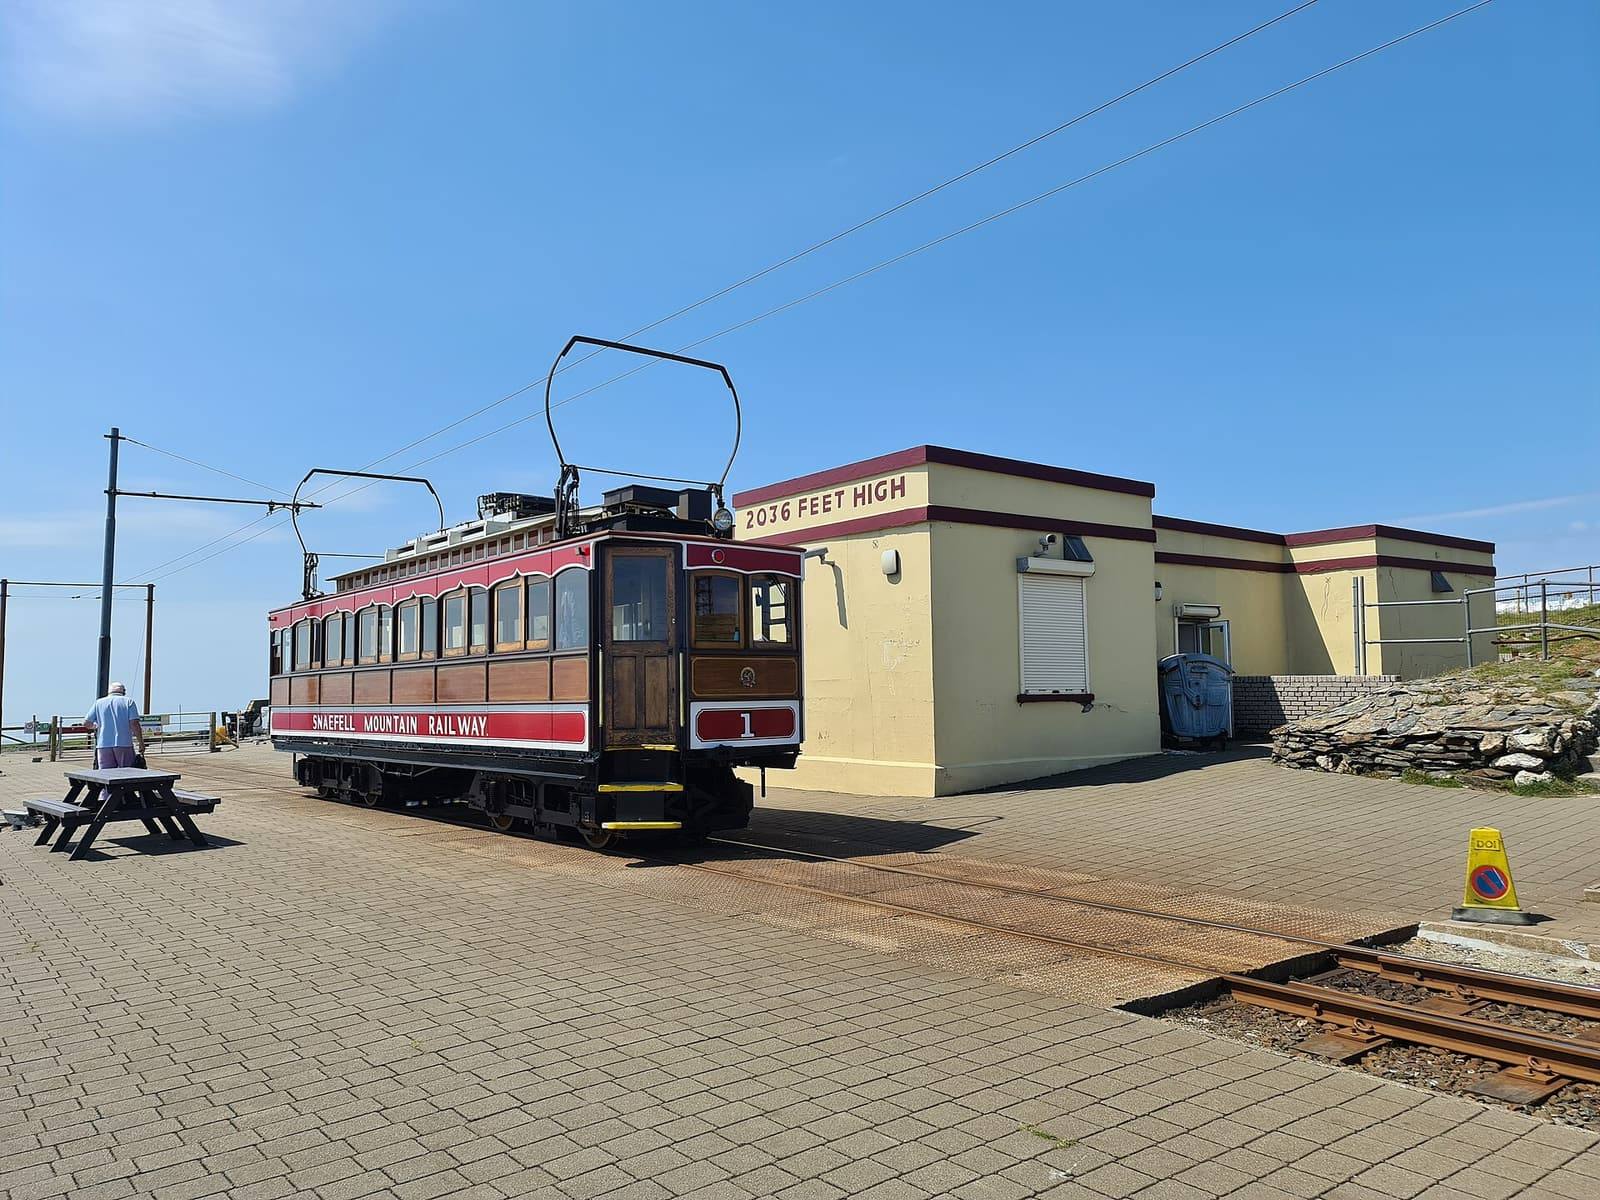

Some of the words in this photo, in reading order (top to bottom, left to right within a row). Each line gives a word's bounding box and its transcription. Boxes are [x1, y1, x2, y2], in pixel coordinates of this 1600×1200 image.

[746, 501, 791, 529] 2036
[798, 490, 845, 518] FEET
[853, 475, 906, 507] HIGH
[312, 714, 355, 731] SNAEFELL
[364, 715, 418, 734] MOUNTAIN
[740, 713, 755, 738] 1
